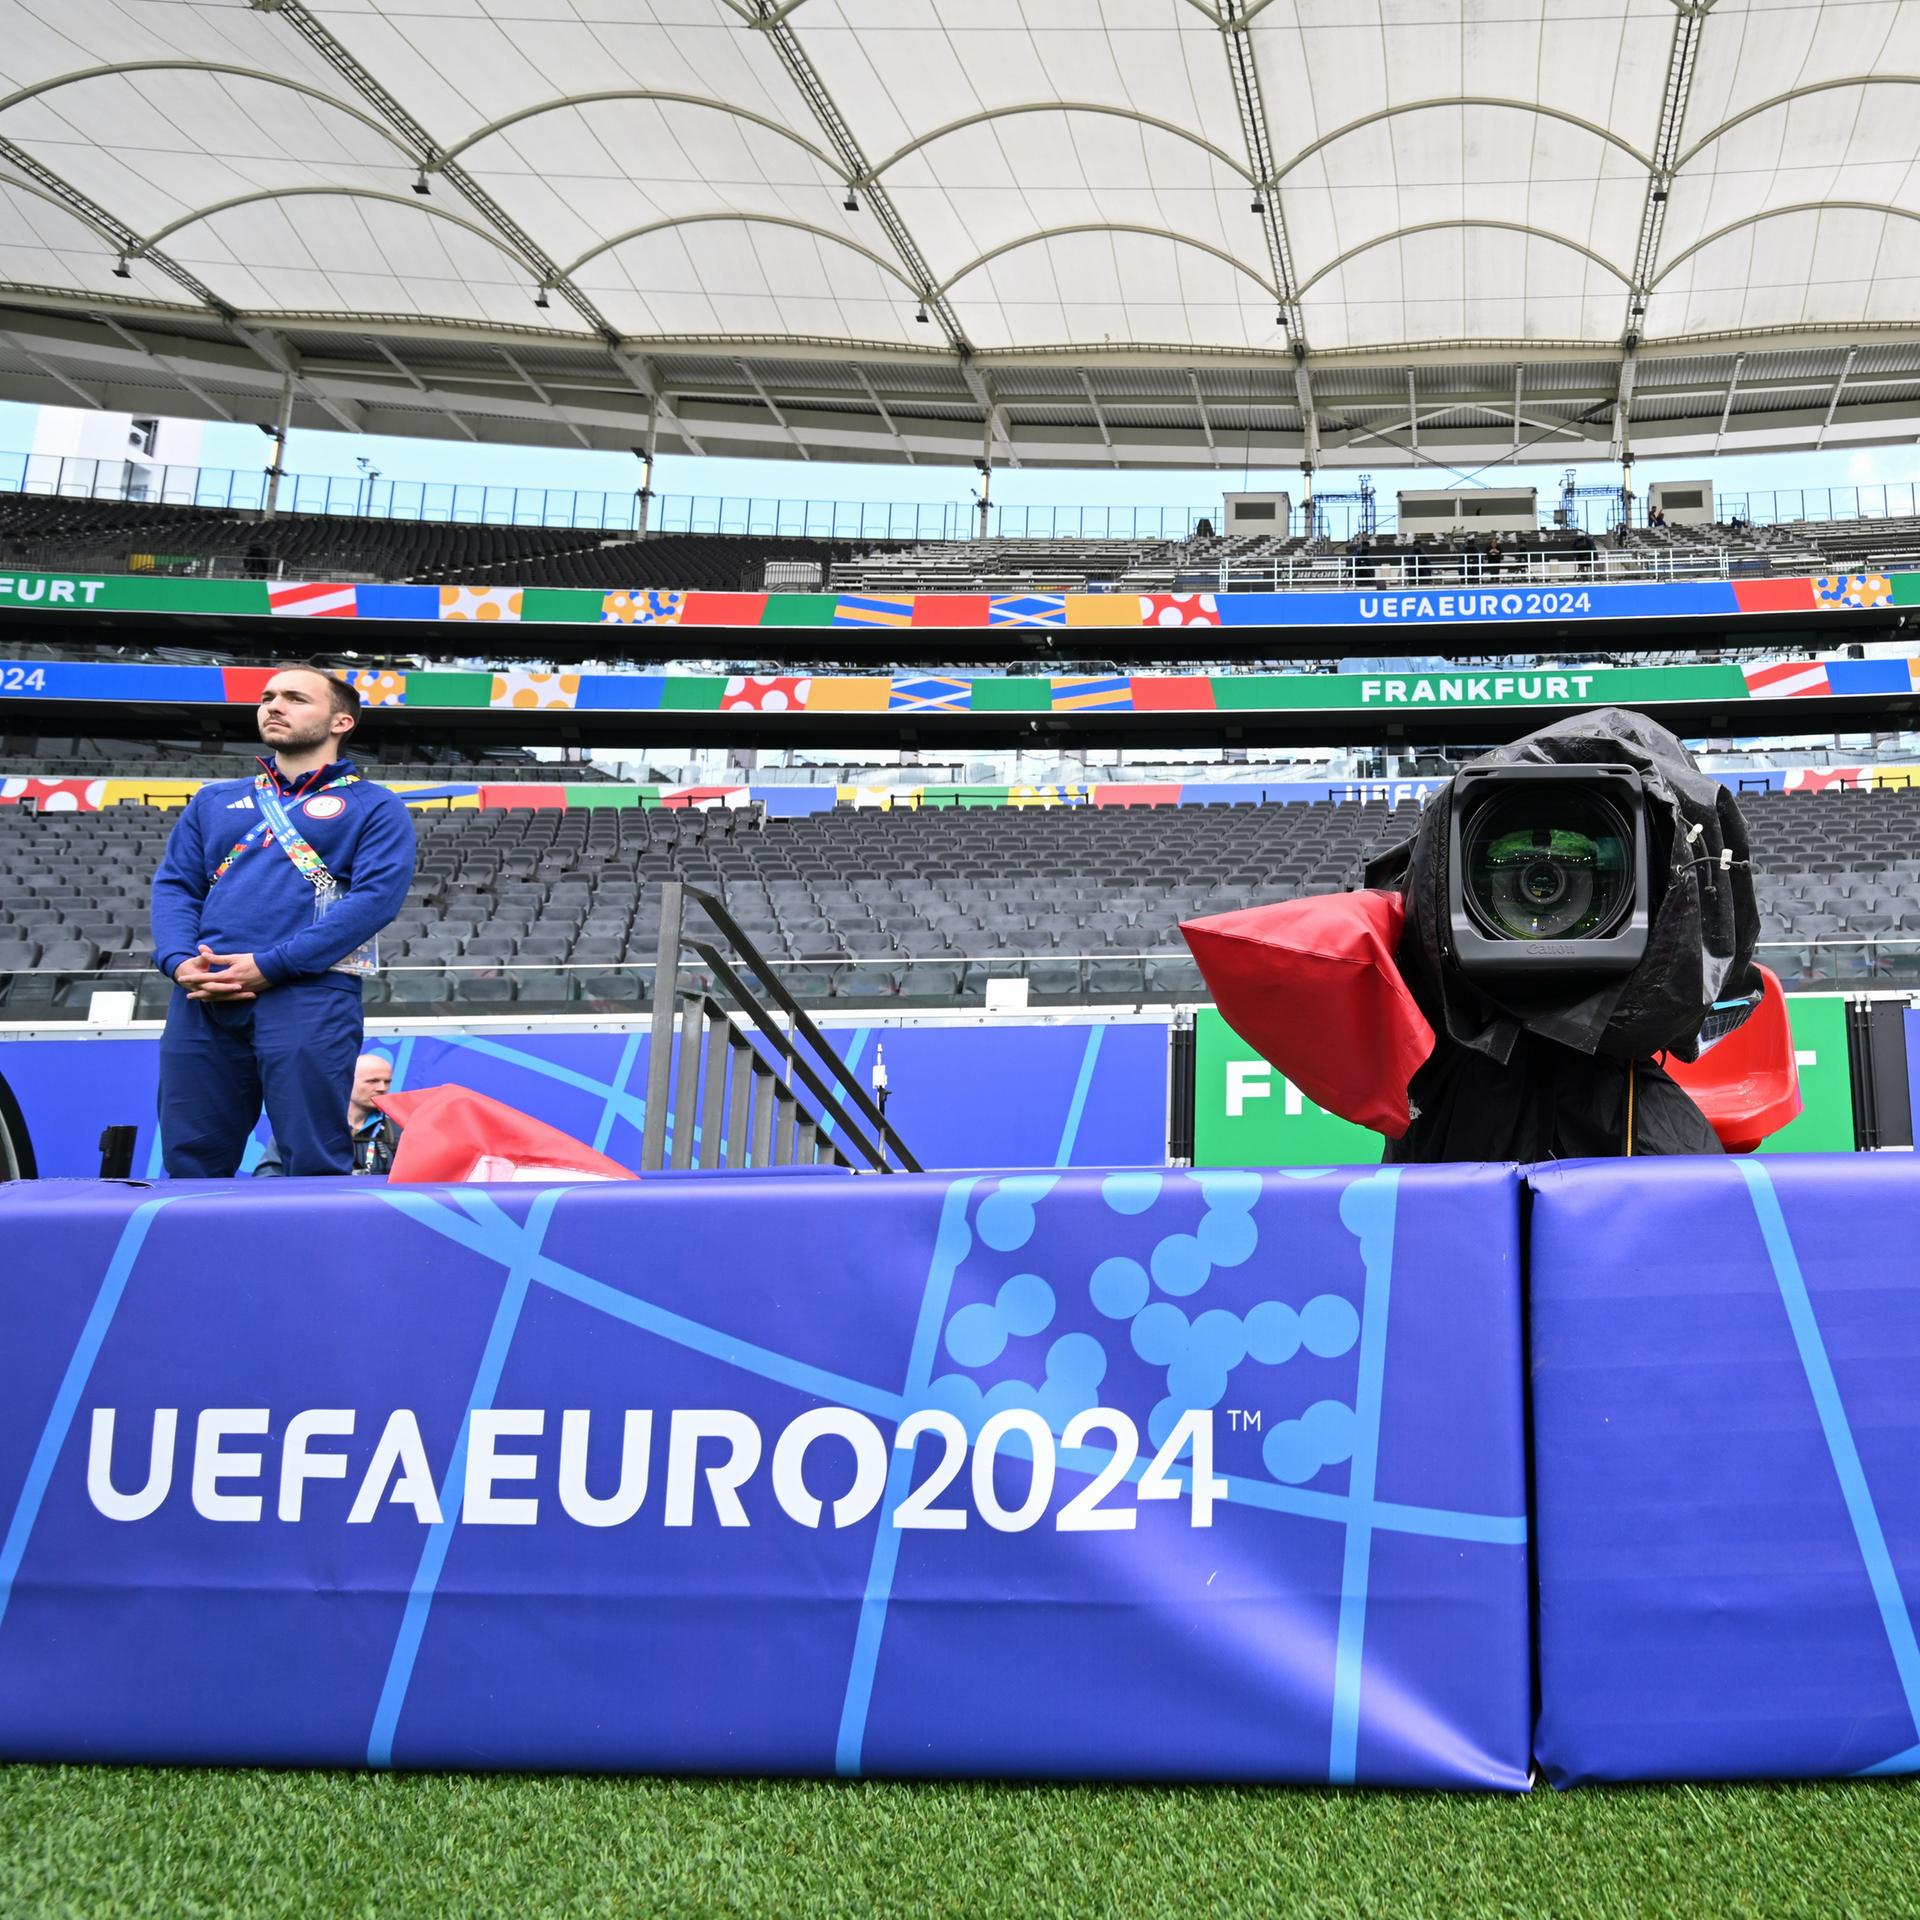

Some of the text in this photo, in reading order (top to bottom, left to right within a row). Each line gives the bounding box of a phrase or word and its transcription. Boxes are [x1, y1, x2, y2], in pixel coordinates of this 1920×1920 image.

[0, 667, 46, 691] 24
[1361, 675, 1594, 702] FRANKFURT
[1345, 783, 1444, 808] UEFA
[1526, 943, 1576, 955] Canon
